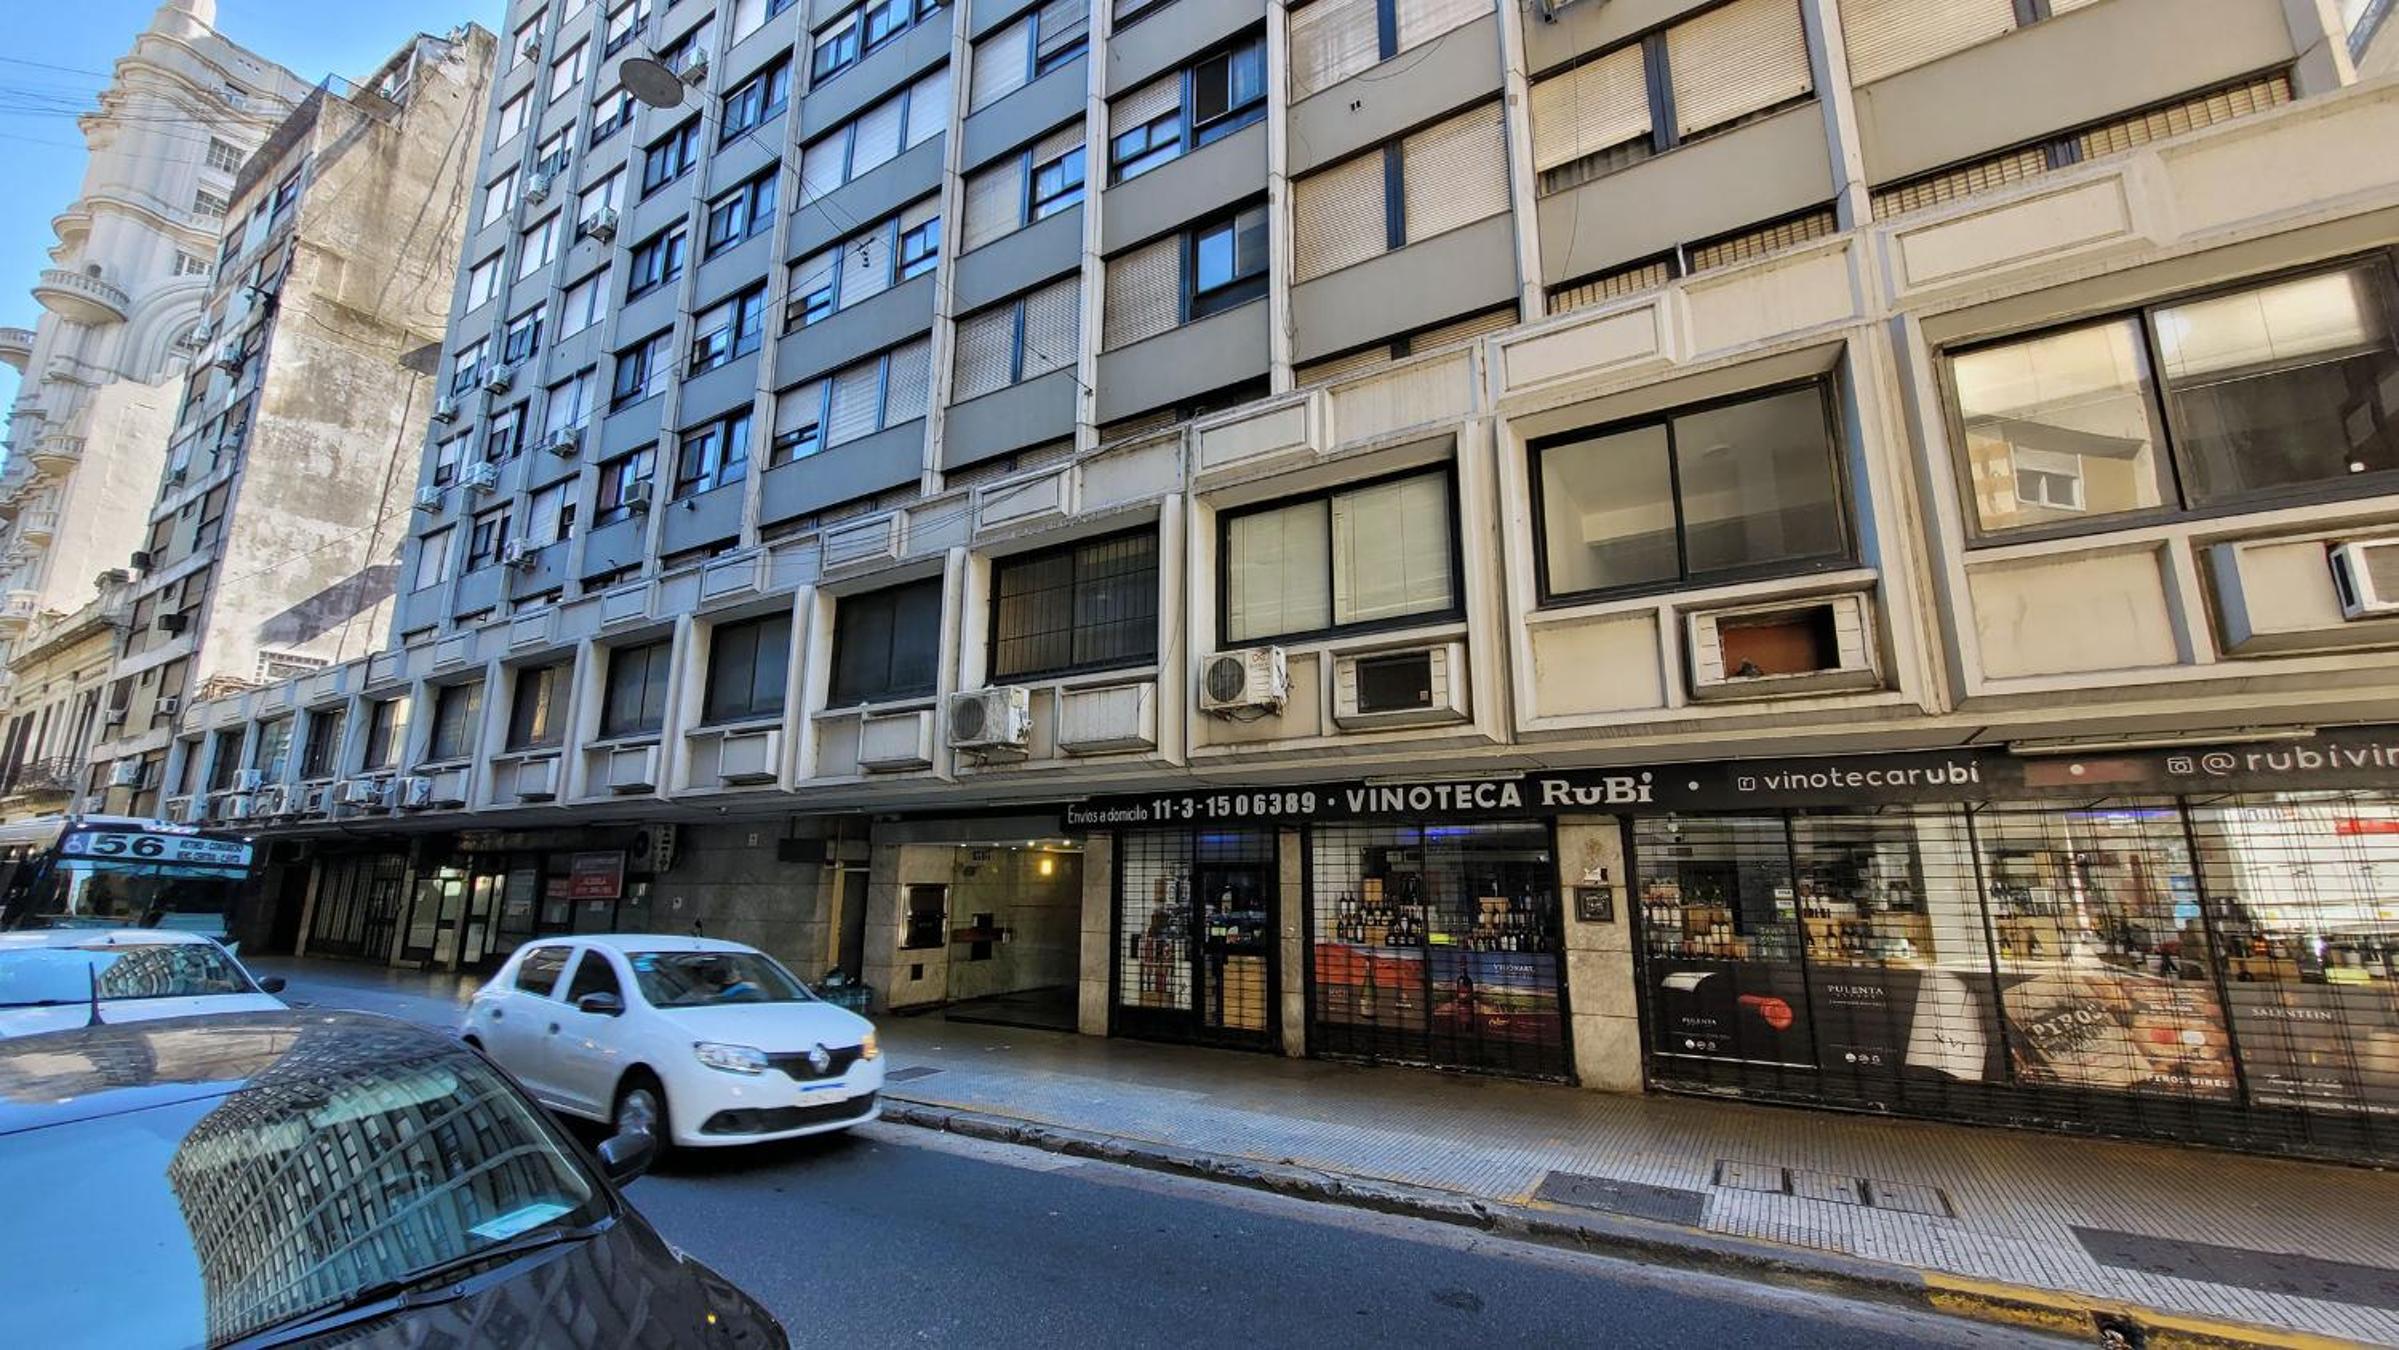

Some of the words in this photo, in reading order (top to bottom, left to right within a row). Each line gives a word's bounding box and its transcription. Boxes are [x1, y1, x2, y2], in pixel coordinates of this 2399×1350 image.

[1346, 782, 1522, 813] VINOTECA
[1540, 772, 1654, 806] RuBi
[1107, 804, 1148, 822] domicilio
[93, 834, 166, 857] 56
[1827, 984, 1884, 995] PULENTA
